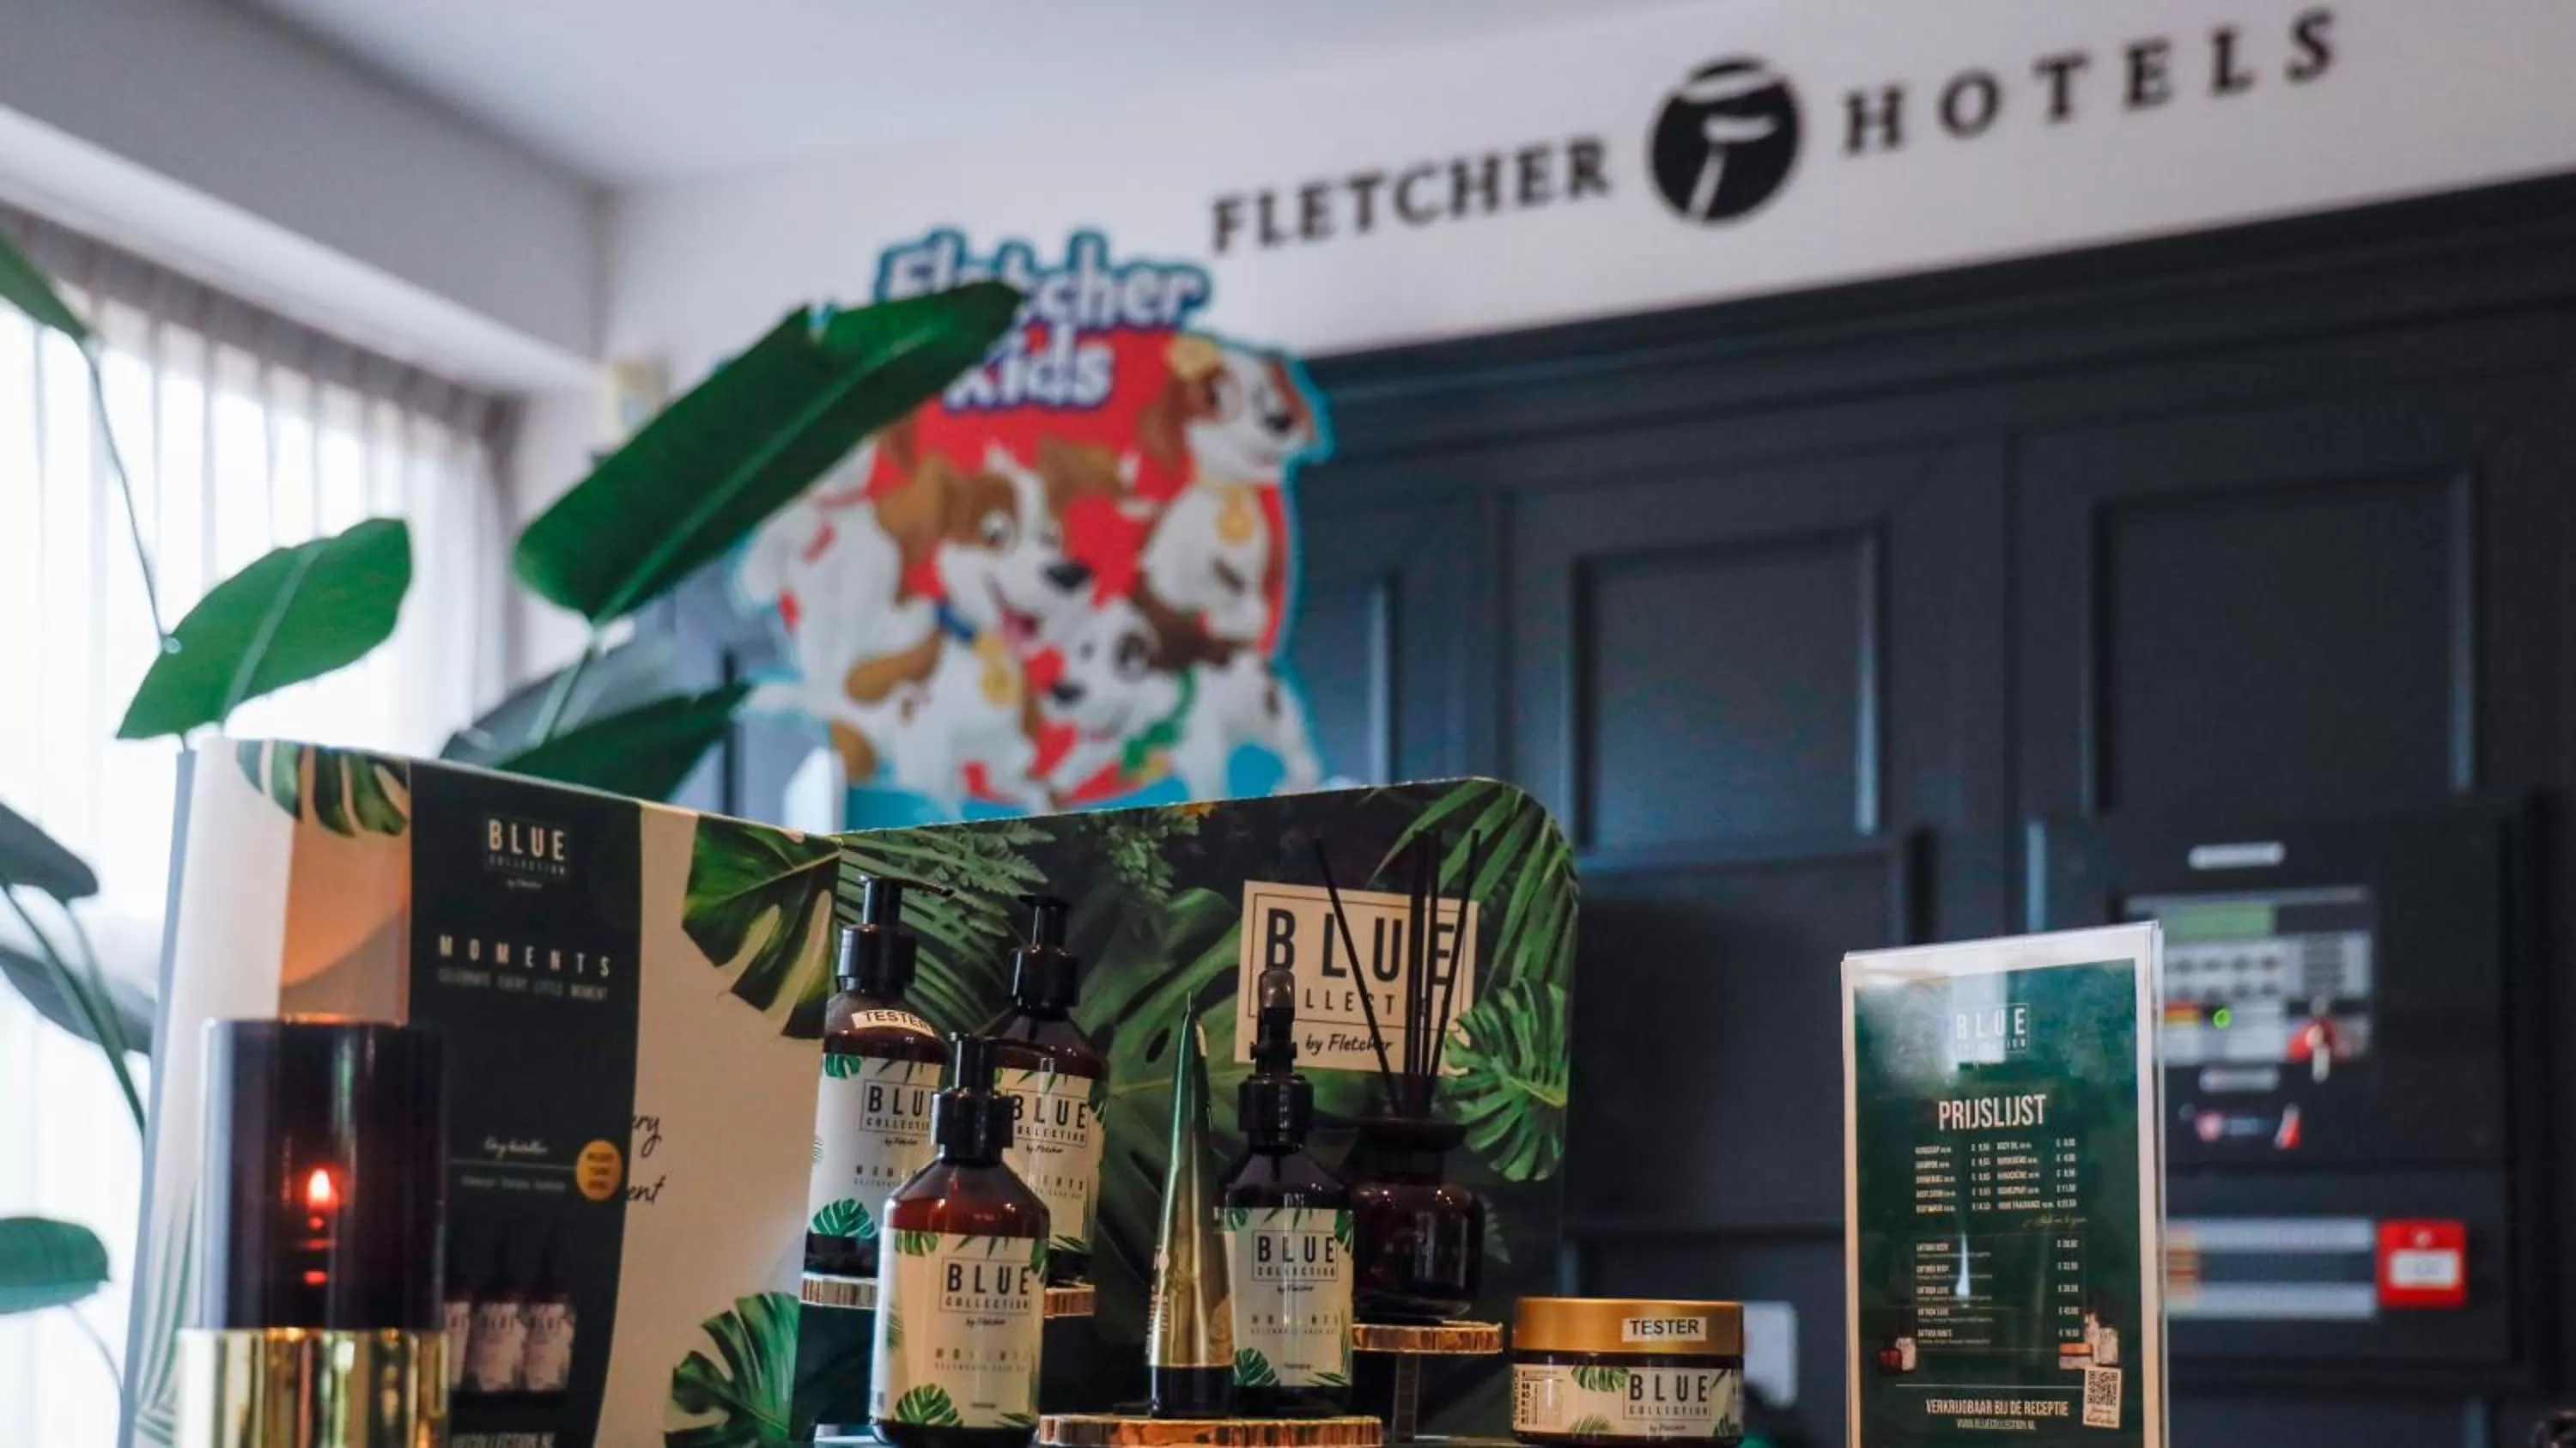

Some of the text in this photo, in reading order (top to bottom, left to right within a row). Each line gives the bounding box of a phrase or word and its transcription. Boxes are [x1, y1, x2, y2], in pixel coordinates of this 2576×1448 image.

[1211, 137, 1614, 256] FLETCHER
[1839, 8, 2337, 159] HOTELS
[488, 819, 565, 861] BLUE
[440, 934, 611, 977] MOMENTS
[1265, 907, 1457, 986] BLUE
[1956, 1007, 2026, 1041] BLUE
[1305, 1033, 1323, 1056] by
[867, 1085, 933, 1117] BLU
[1012, 1094, 1087, 1129] BLUE
[1938, 1093, 2047, 1131] PRIJSLIJST
[1257, 1235, 1335, 1264] BLUE
[946, 1263, 1030, 1296] BLUE
[1630, 1319, 1699, 1335] TESTER
[1629, 1374, 1709, 1402] BLUE
